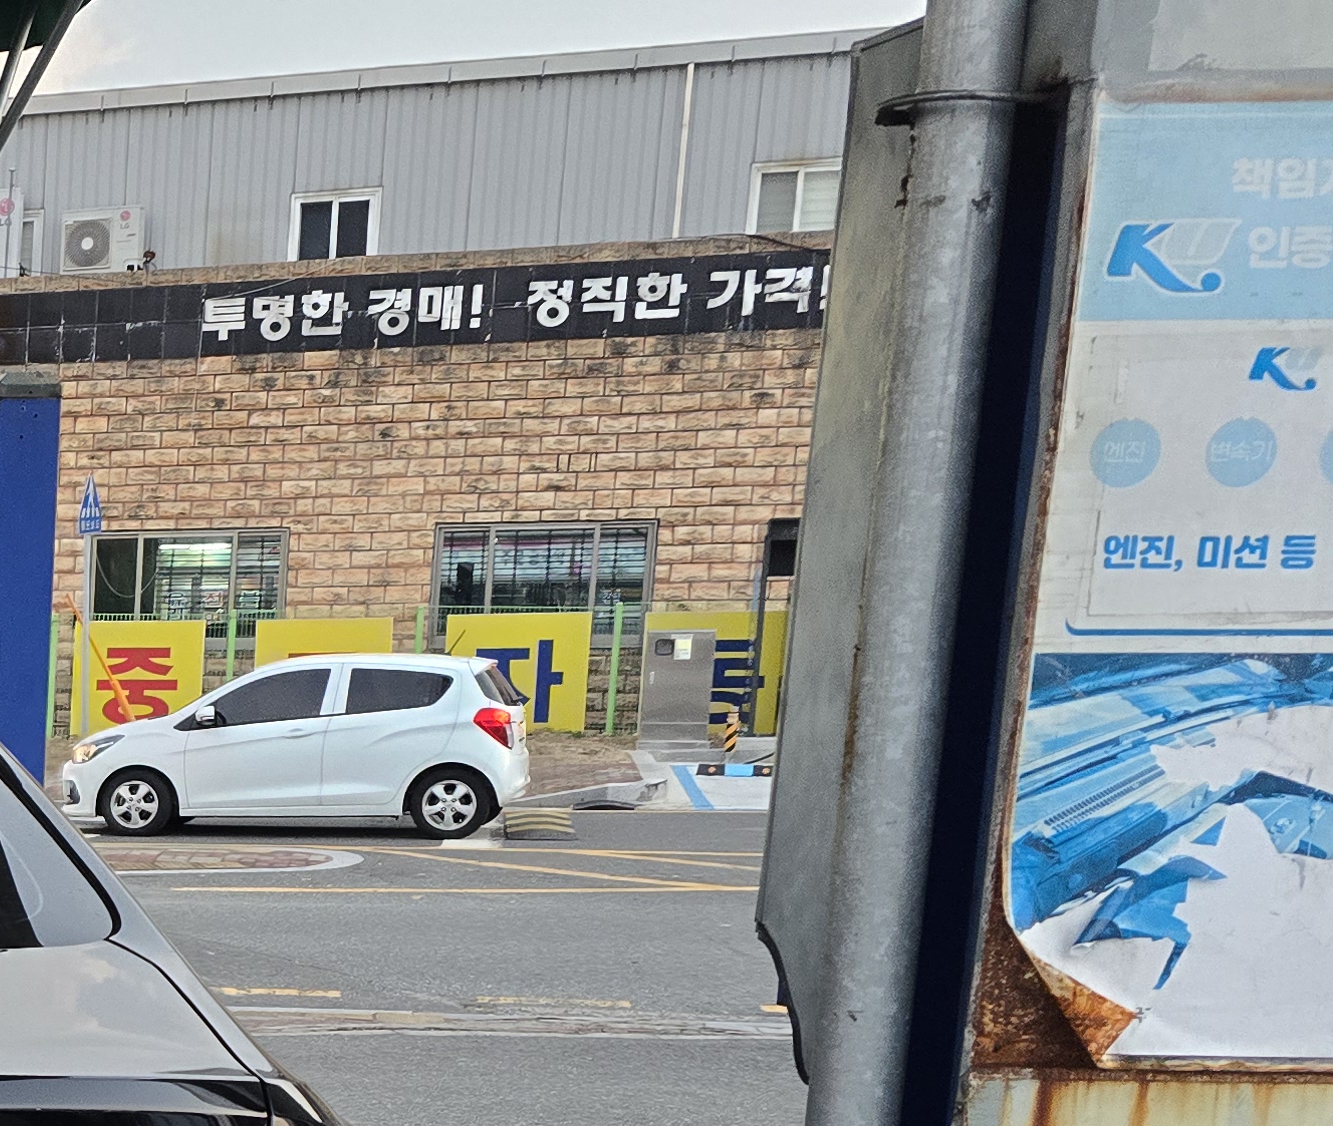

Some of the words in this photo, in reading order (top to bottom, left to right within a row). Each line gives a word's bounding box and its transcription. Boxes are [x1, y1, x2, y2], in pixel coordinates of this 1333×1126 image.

[202, 289, 349, 342] 투명한
[367, 284, 484, 337] 경매!
[527, 272, 688, 328] 정직한
[1103, 534, 1183, 572] 엔진,
[1197, 535, 1270, 570] 미션
[1280, 534, 1317, 570] 등
